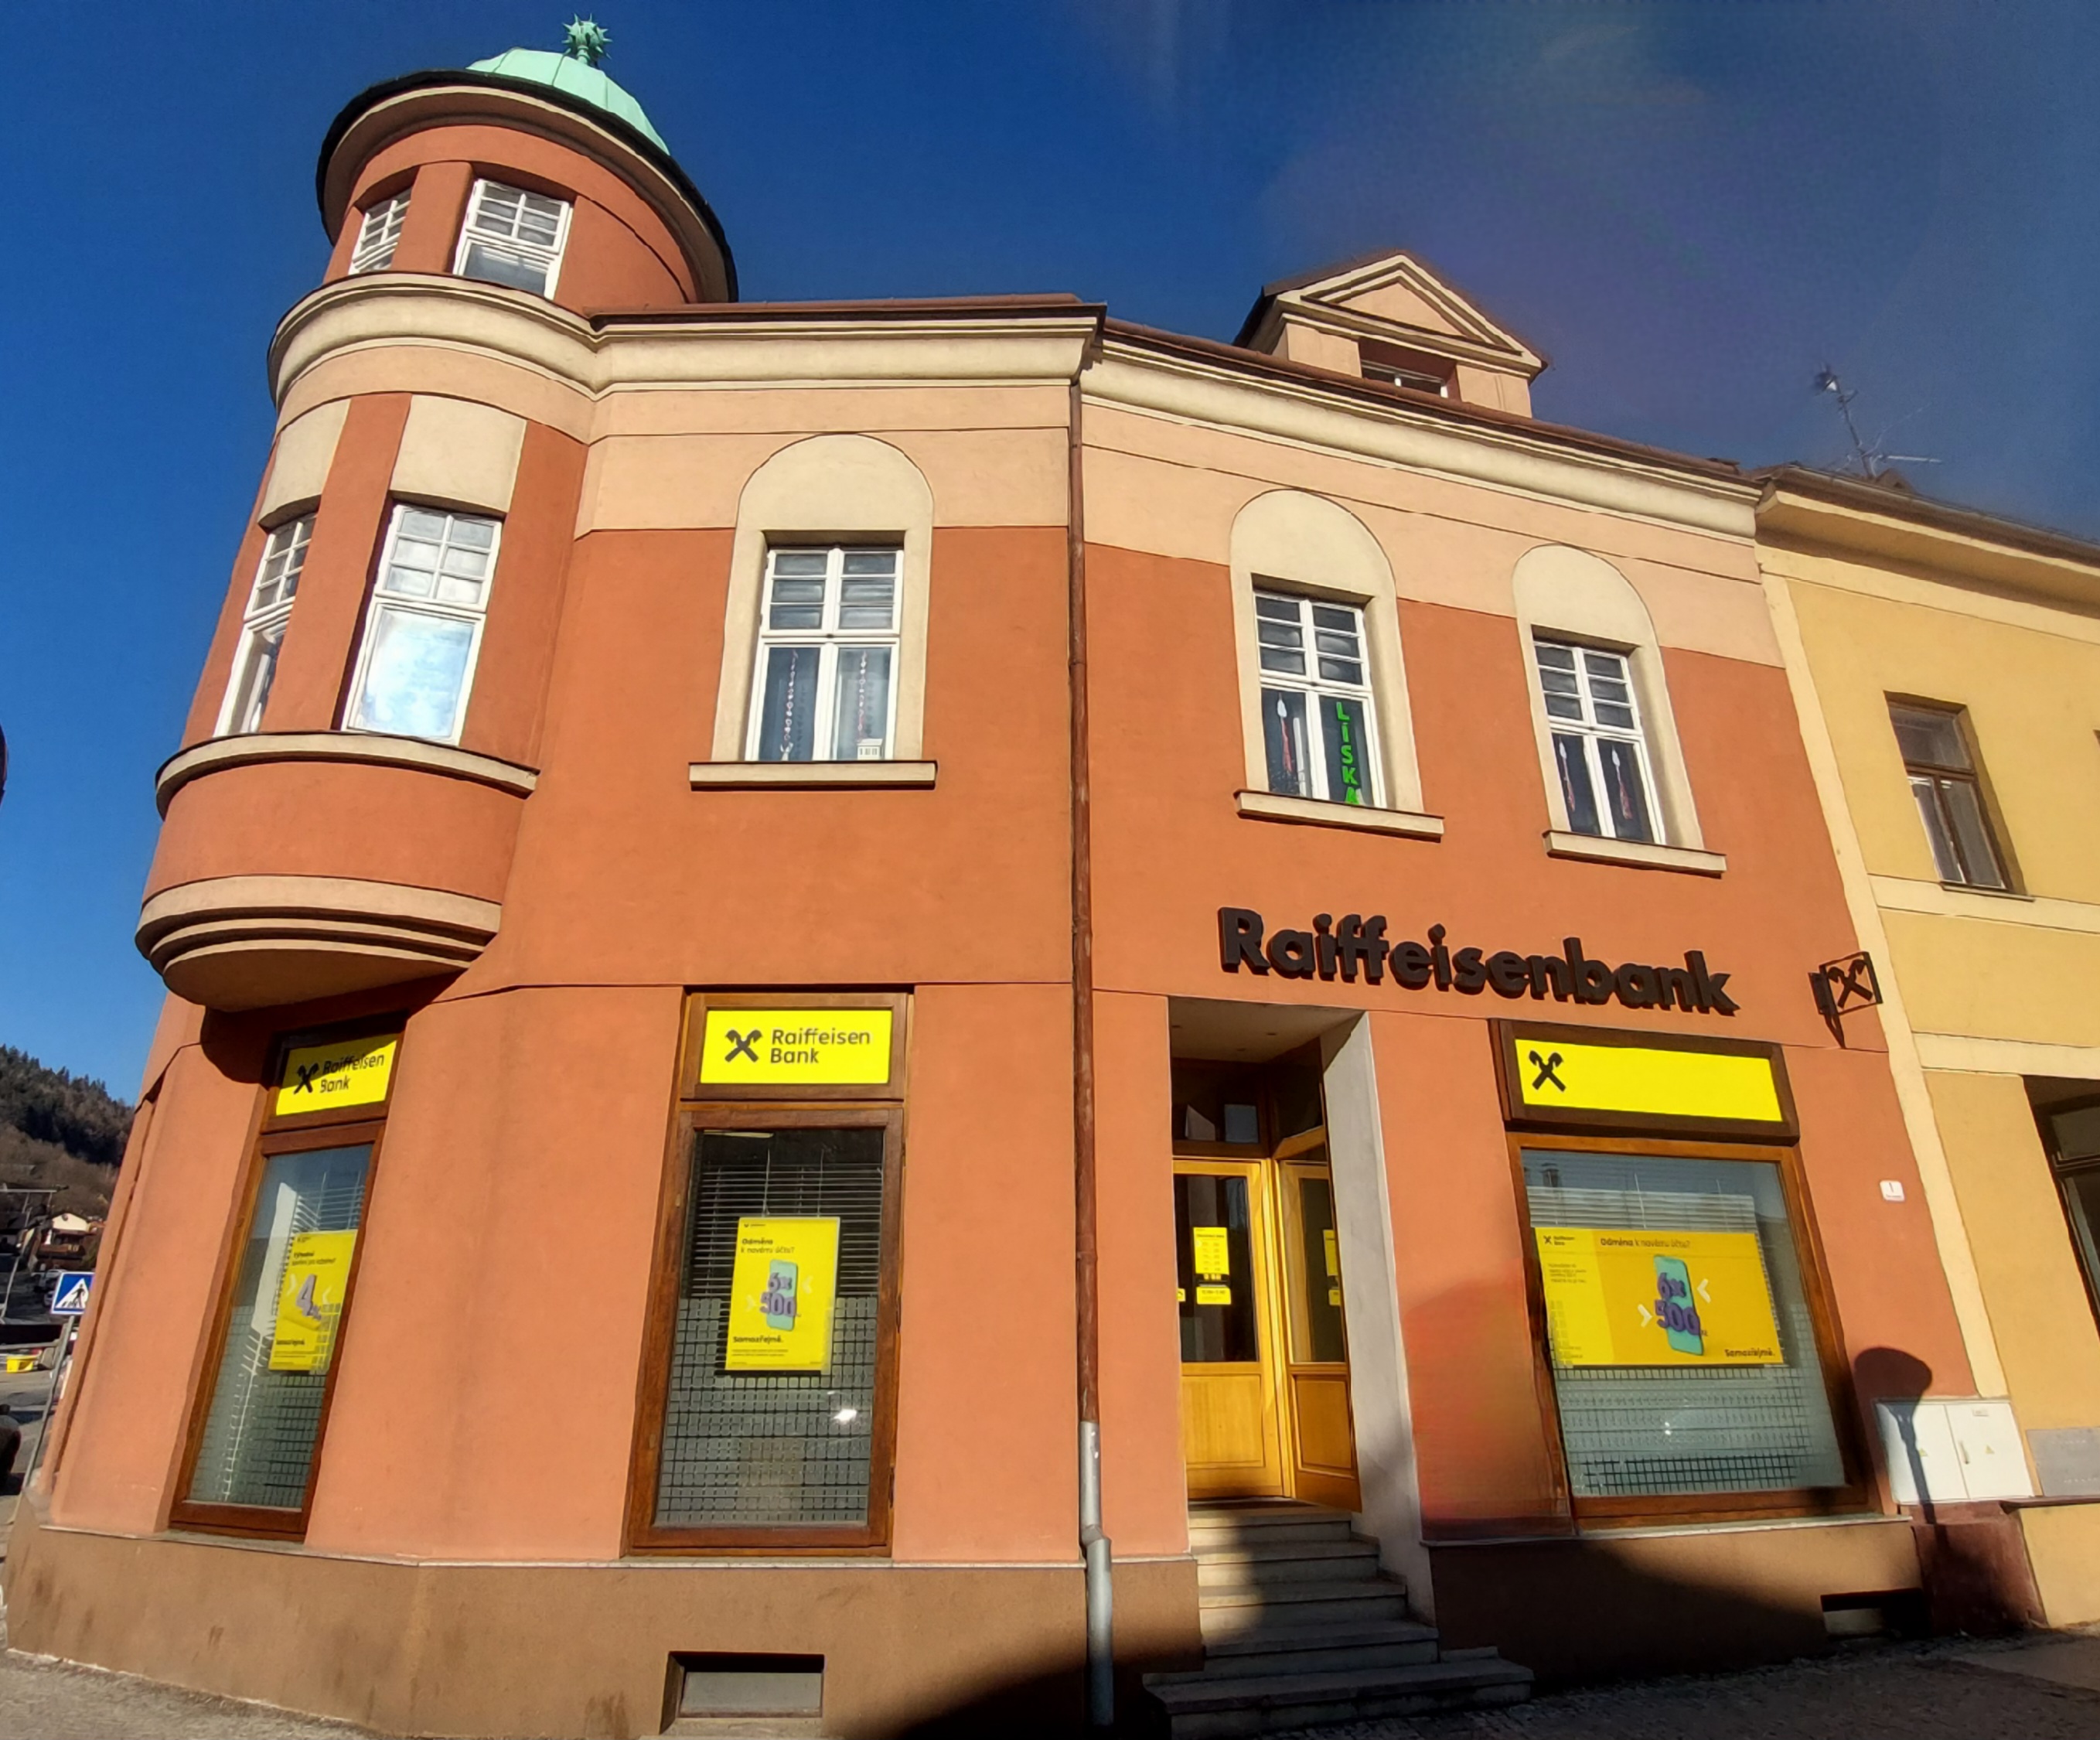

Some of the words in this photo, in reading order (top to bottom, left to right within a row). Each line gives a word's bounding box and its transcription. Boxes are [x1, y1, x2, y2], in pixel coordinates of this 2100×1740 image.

[1218, 906, 1741, 1017] Raiffeisenbank
[772, 1027, 871, 1046] Raiffeisen
[322, 1053, 385, 1075] Raiffeisen
[770, 1047, 820, 1064] Bank
[320, 1074, 351, 1093] Bank
[1657, 1272, 1686, 1300] 6x
[759, 1291, 797, 1318] 500
[1655, 1299, 1701, 1336] 500
